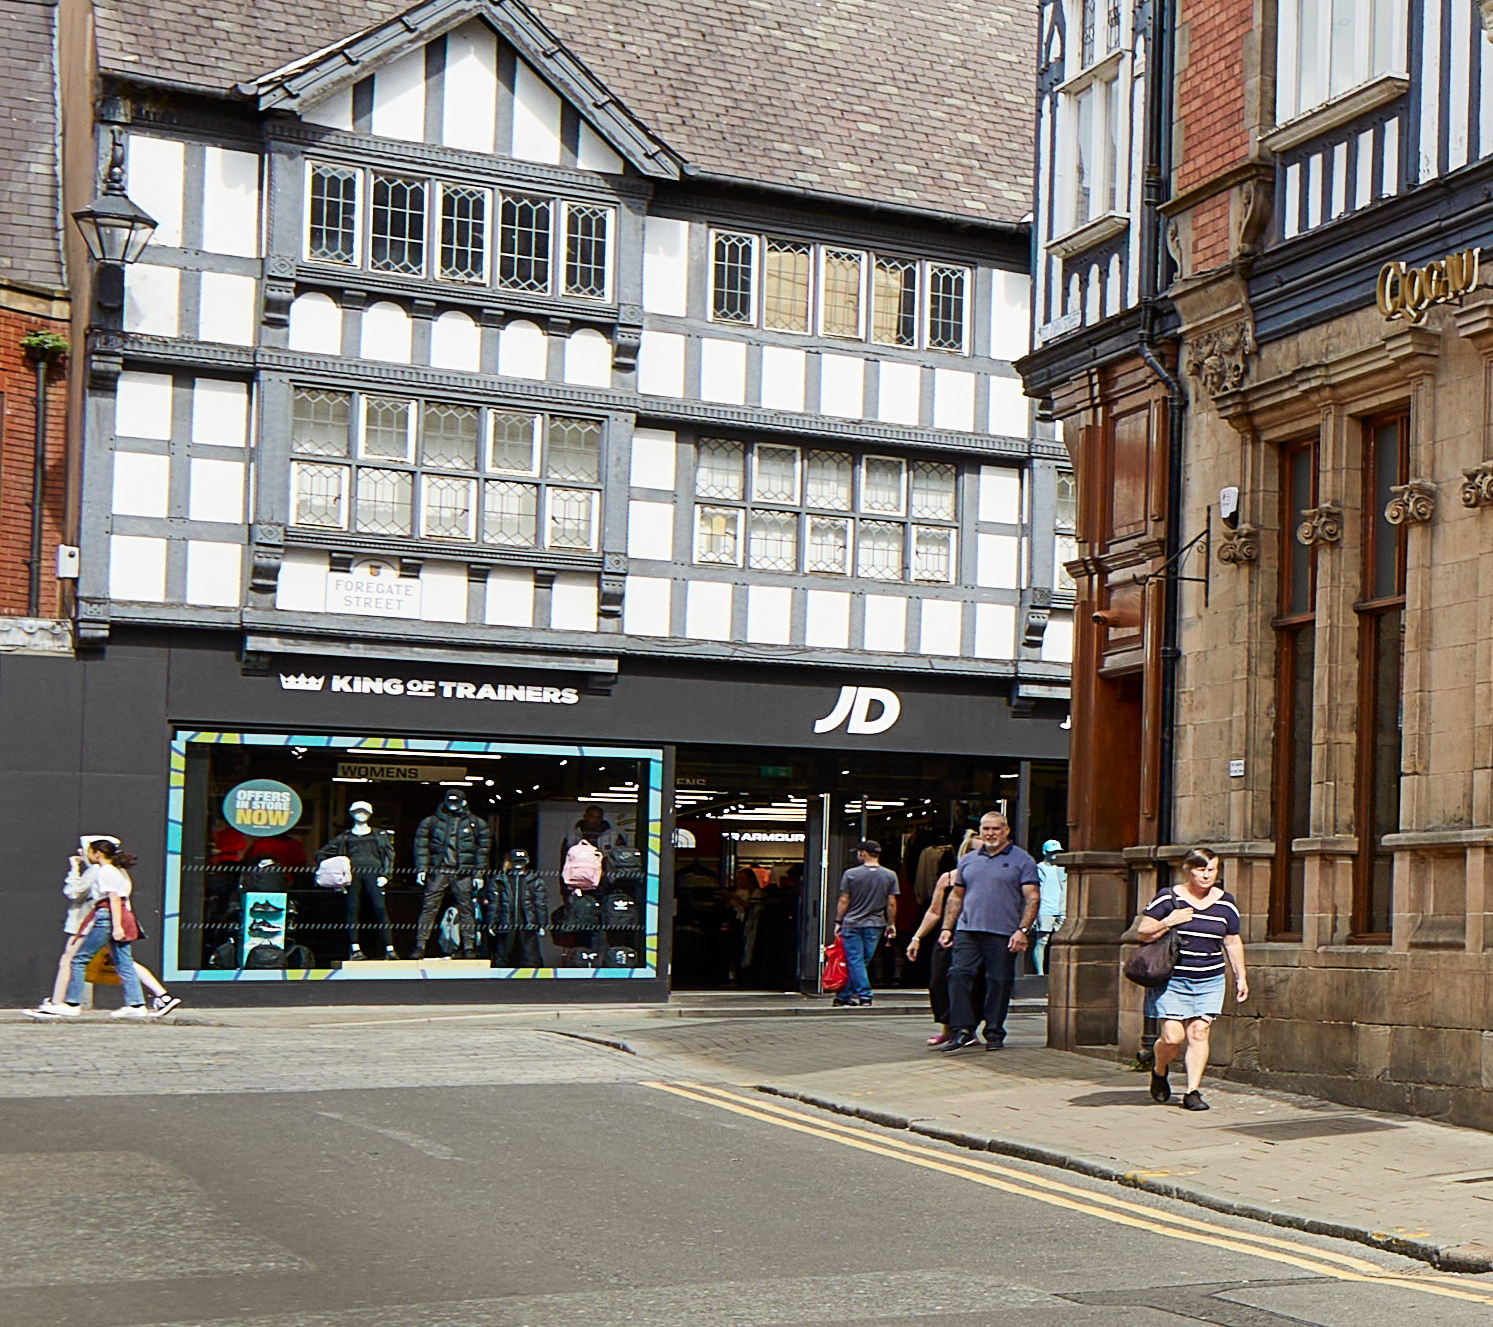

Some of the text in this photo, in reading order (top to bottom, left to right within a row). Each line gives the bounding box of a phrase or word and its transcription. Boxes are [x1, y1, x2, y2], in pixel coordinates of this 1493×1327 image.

[335, 579, 413, 597] FOREGATE
[343, 596, 404, 611] STREET
[331, 675, 579, 705] KING OF TRAINERS
[813, 685, 901, 735] JD
[341, 765, 419, 779] WOMENS
[236, 790, 291, 802] OFFERS
[236, 801, 290, 811] IN STORE
[235, 809, 290, 826] NOW
[741, 833, 806, 842] ARMOUR
